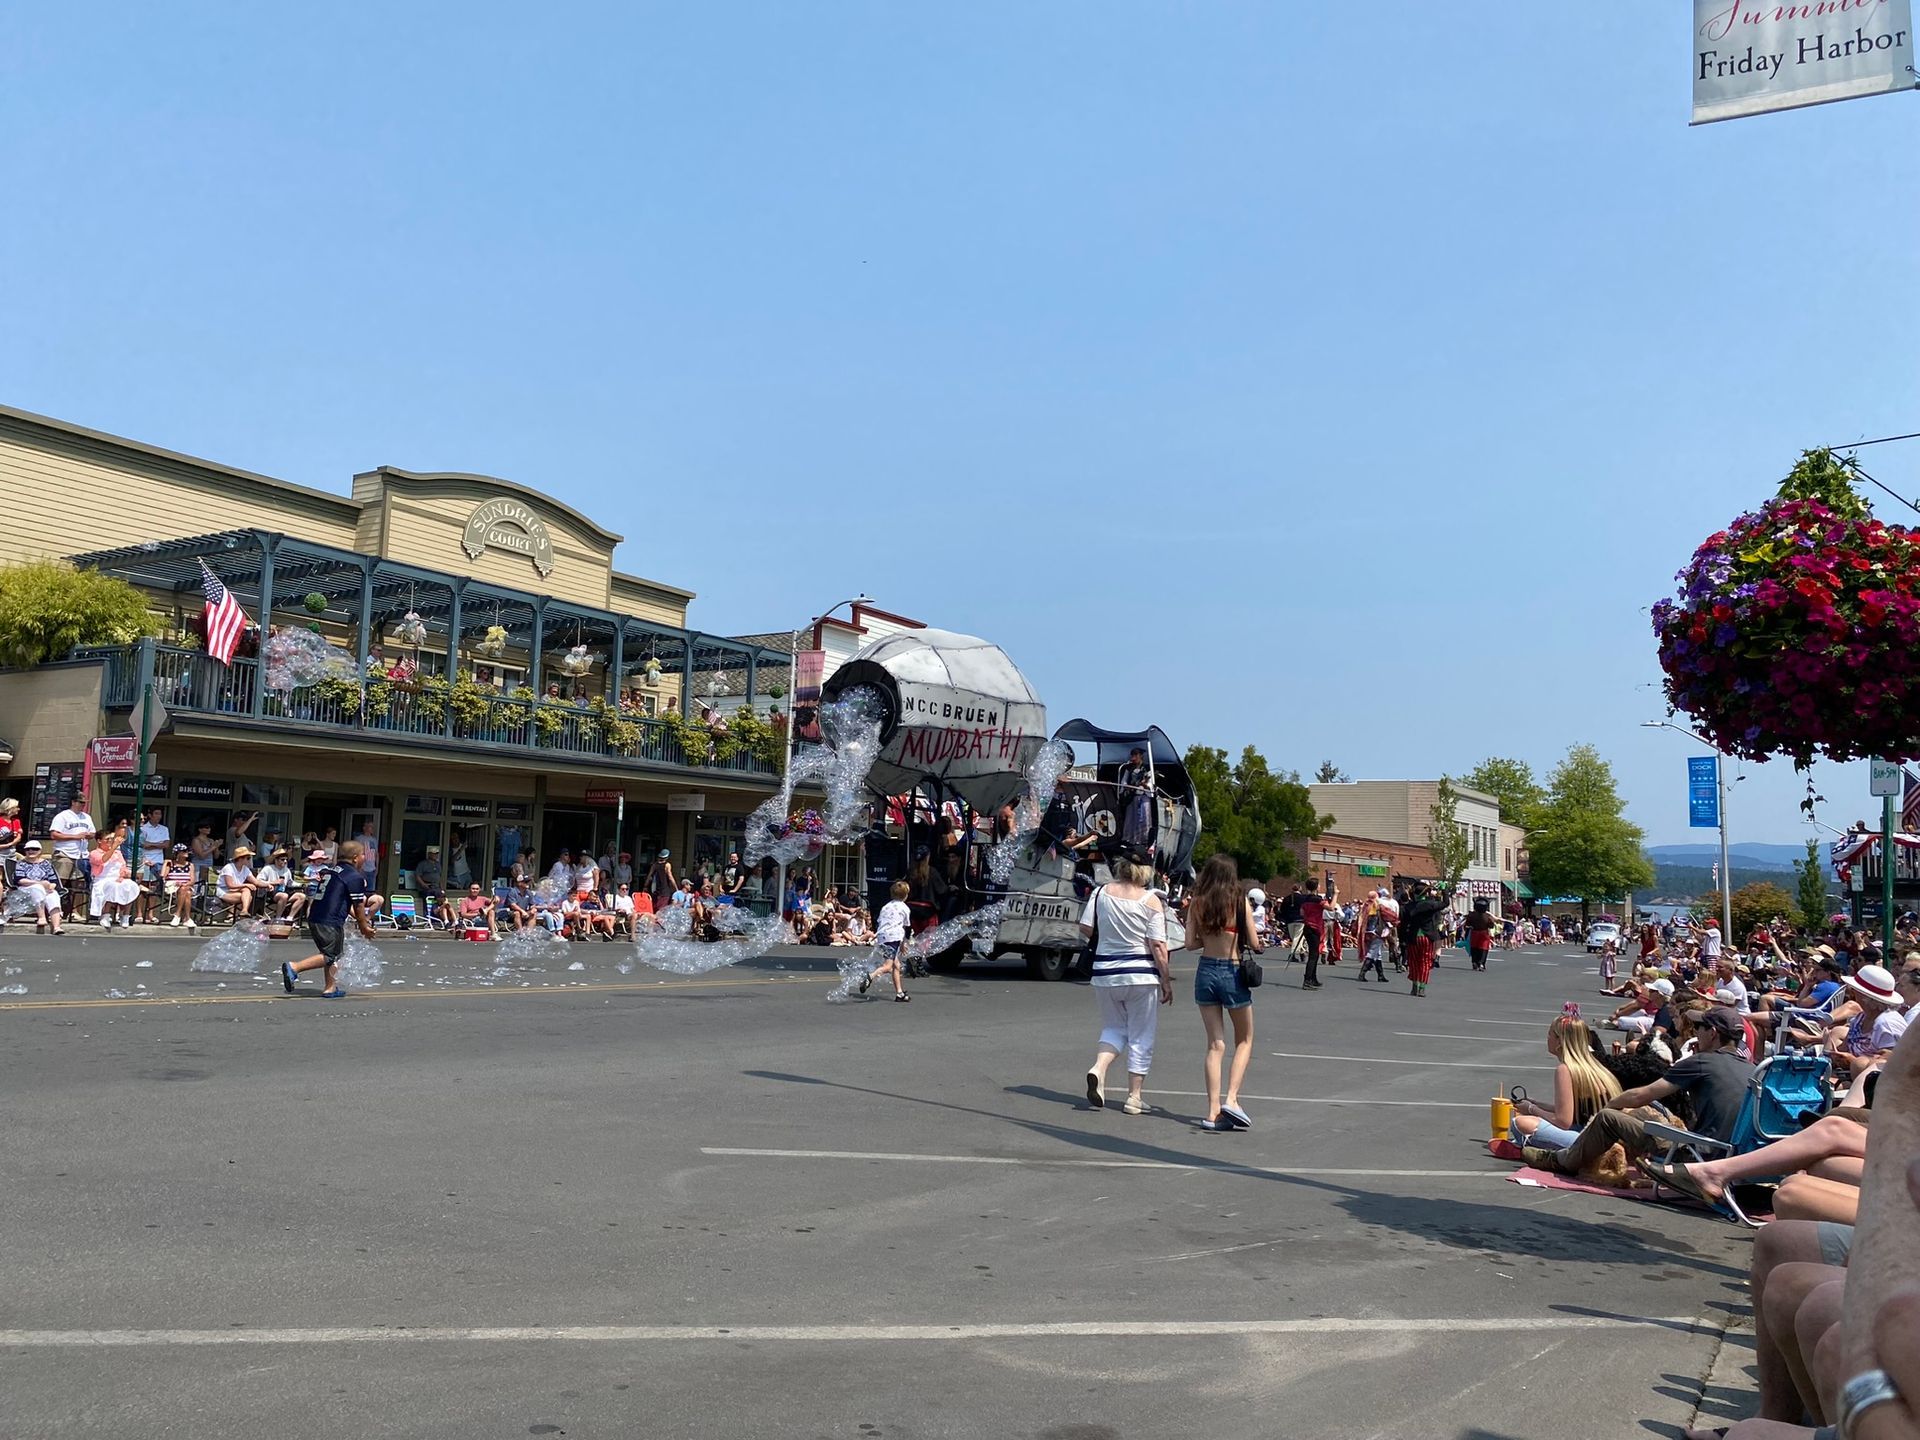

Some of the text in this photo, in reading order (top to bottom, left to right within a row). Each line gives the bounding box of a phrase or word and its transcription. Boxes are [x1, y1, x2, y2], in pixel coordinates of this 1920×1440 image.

[1700, 0, 1887, 42] Summ
[1698, 27, 1907, 81] Friday Harbor
[472, 503, 549, 551] SUNDRIES
[489, 530, 532, 551] COURT
[897, 725, 1023, 769] MUDBATH!
[179, 786, 231, 796] BIKE RENTALS
[465, 804, 489, 813] RENTALS
